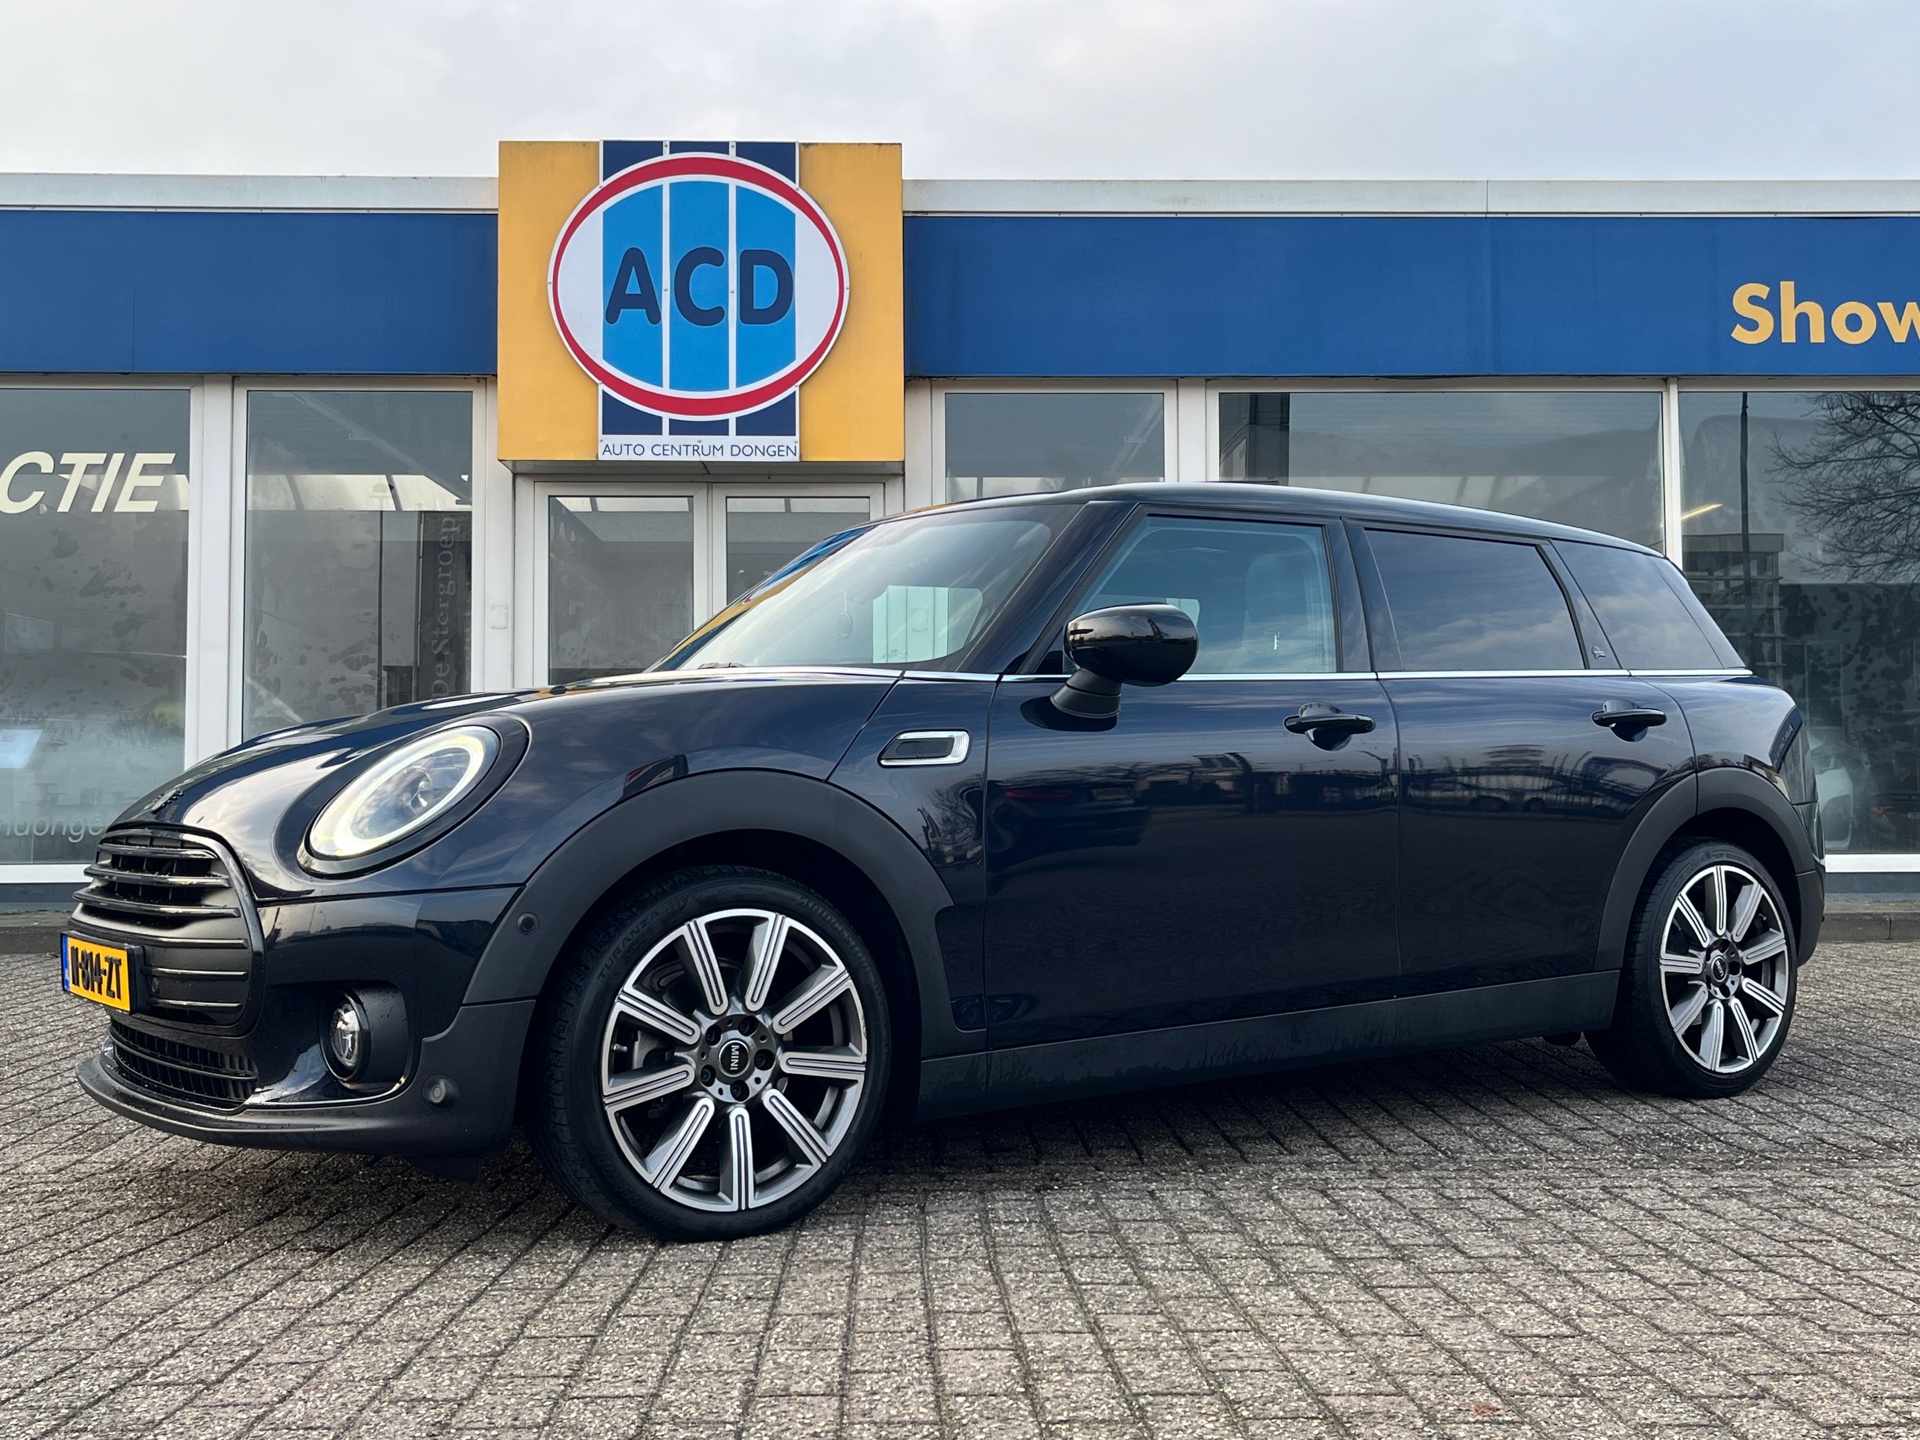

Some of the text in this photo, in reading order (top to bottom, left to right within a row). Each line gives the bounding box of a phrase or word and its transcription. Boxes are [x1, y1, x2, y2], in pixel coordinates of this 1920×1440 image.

[605, 246, 794, 327] ACD
[1731, 280, 1920, 344] Show
[0, 450, 177, 514] CTIE
[602, 443, 797, 458] AUTO CENTRUM DONGEN
[431, 516, 461, 656] Stergroep
[597, 909, 662, 981] TURANZA
[729, 1044, 741, 1072] MINI
